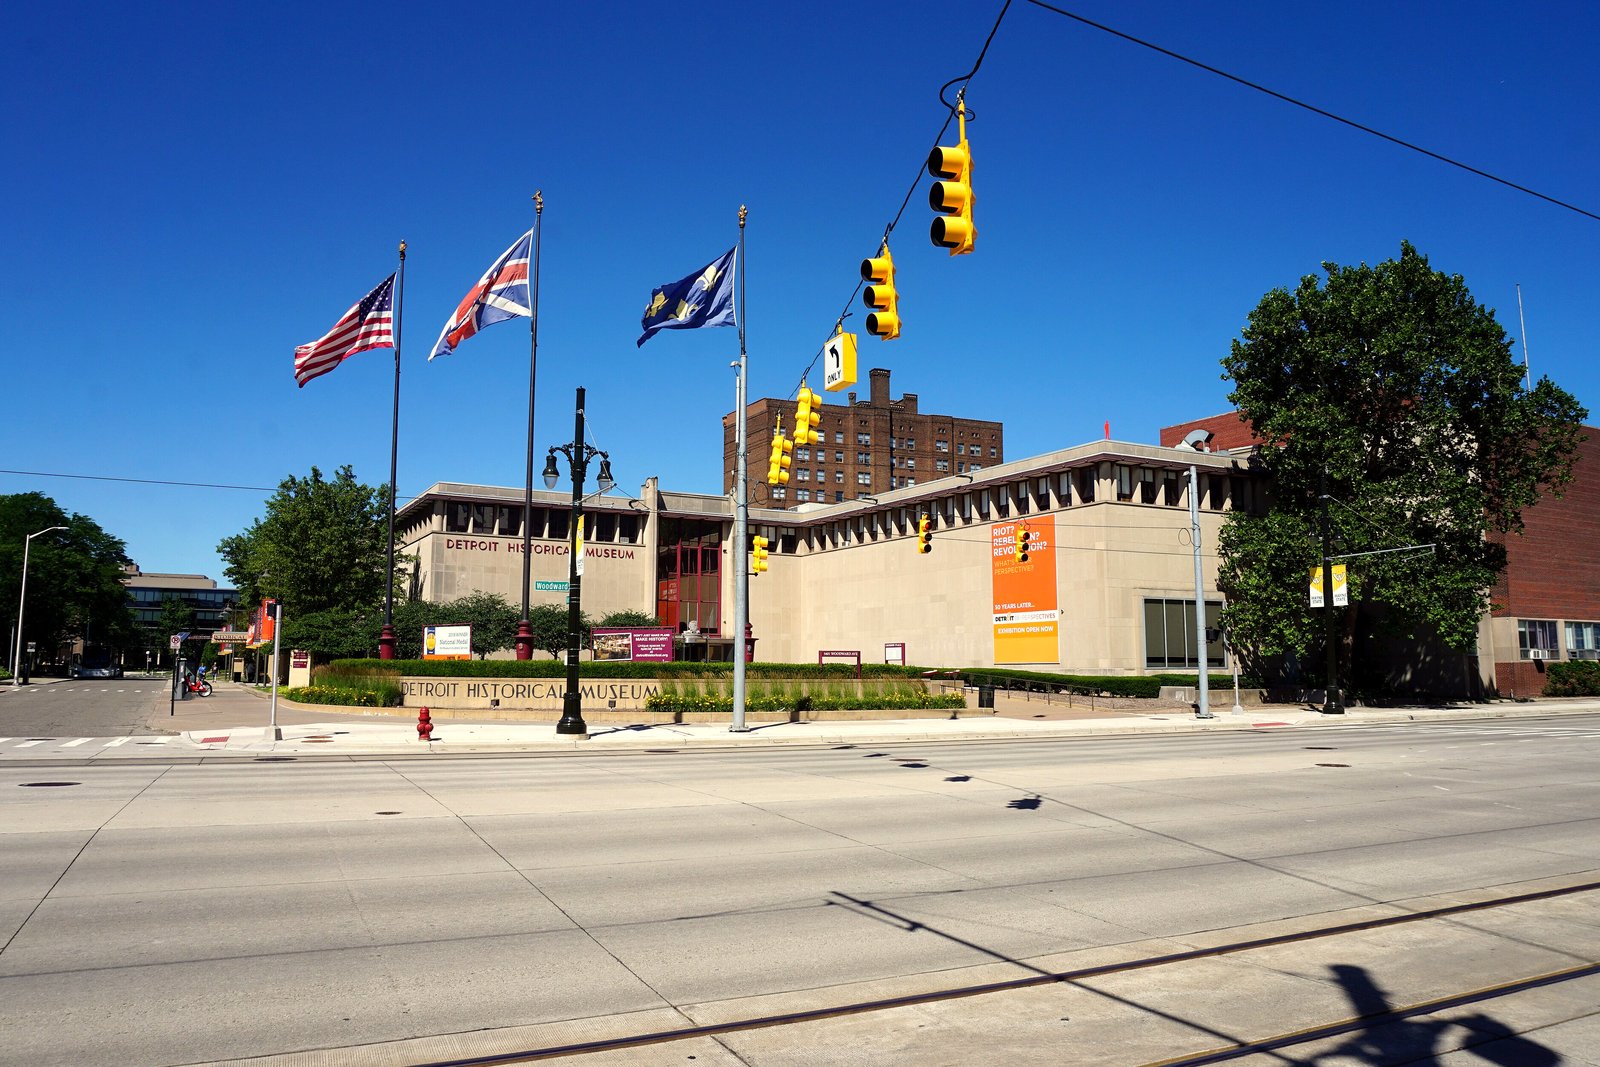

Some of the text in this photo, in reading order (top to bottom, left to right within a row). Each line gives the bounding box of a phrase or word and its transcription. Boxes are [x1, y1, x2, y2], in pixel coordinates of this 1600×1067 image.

[828, 370, 841, 384] ONLY
[993, 526, 1014, 536] RIOT?
[993, 532, 1040, 547] REBELN?
[446, 539, 635, 560] DETROIT HISTORICA MUSEUM
[994, 541, 1047, 556] REVOLION?
[994, 565, 1034, 576] PERSPECTIVE?
[401, 682, 659, 700] DETROIT HISTORICAL MUSEUM
